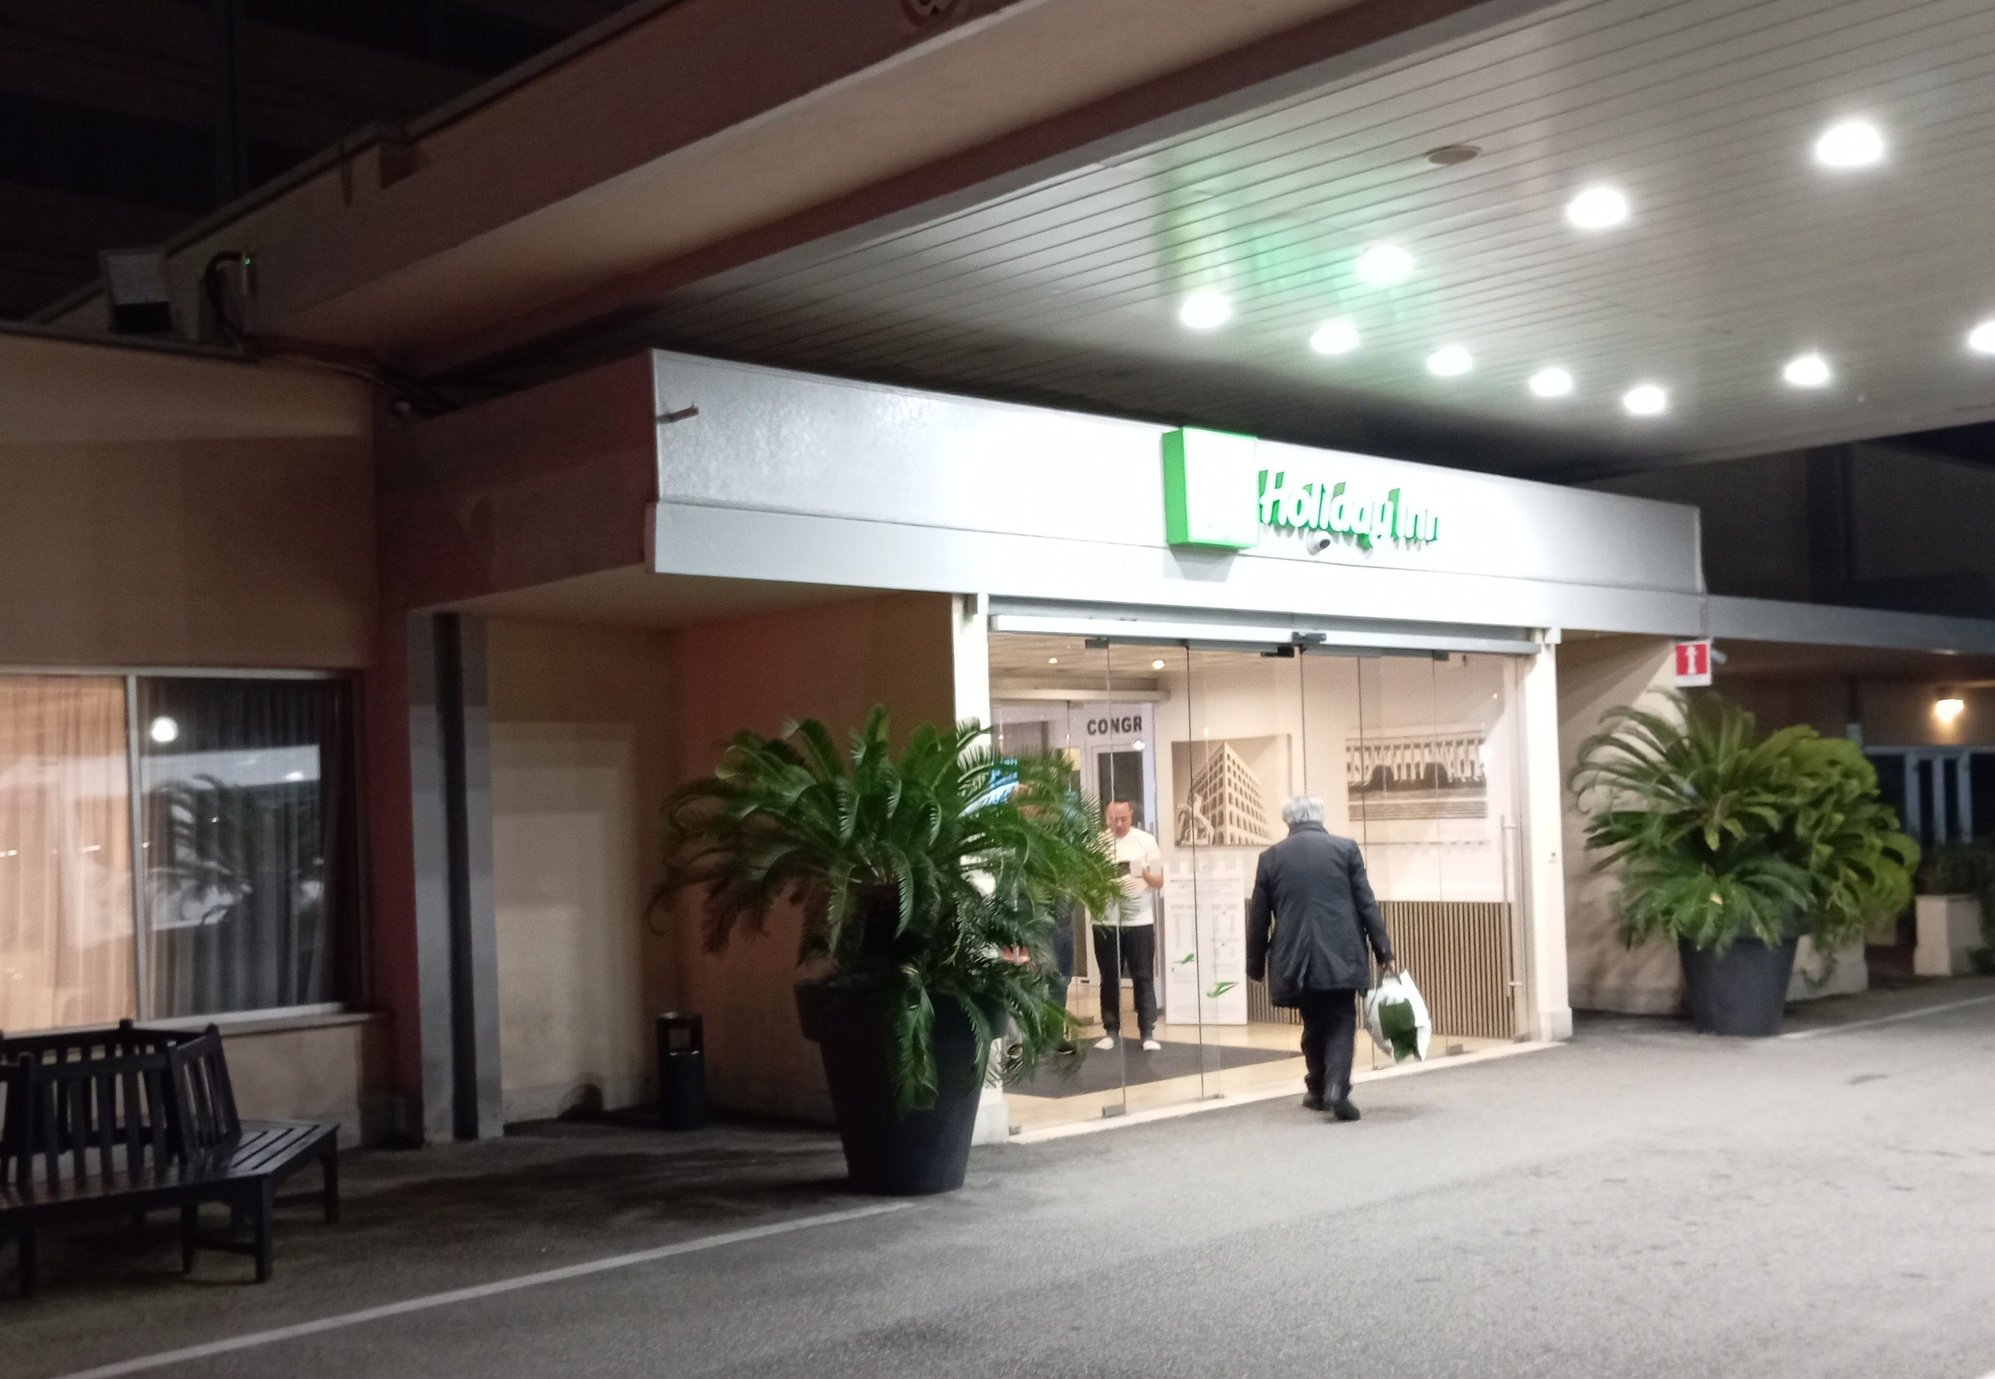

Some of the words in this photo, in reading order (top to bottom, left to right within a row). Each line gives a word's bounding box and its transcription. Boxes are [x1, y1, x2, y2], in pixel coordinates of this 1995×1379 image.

[1258, 469, 1394, 549] Holiday
[1391, 488, 1439, 542] Inn
[1087, 715, 1142, 735] CONGR
